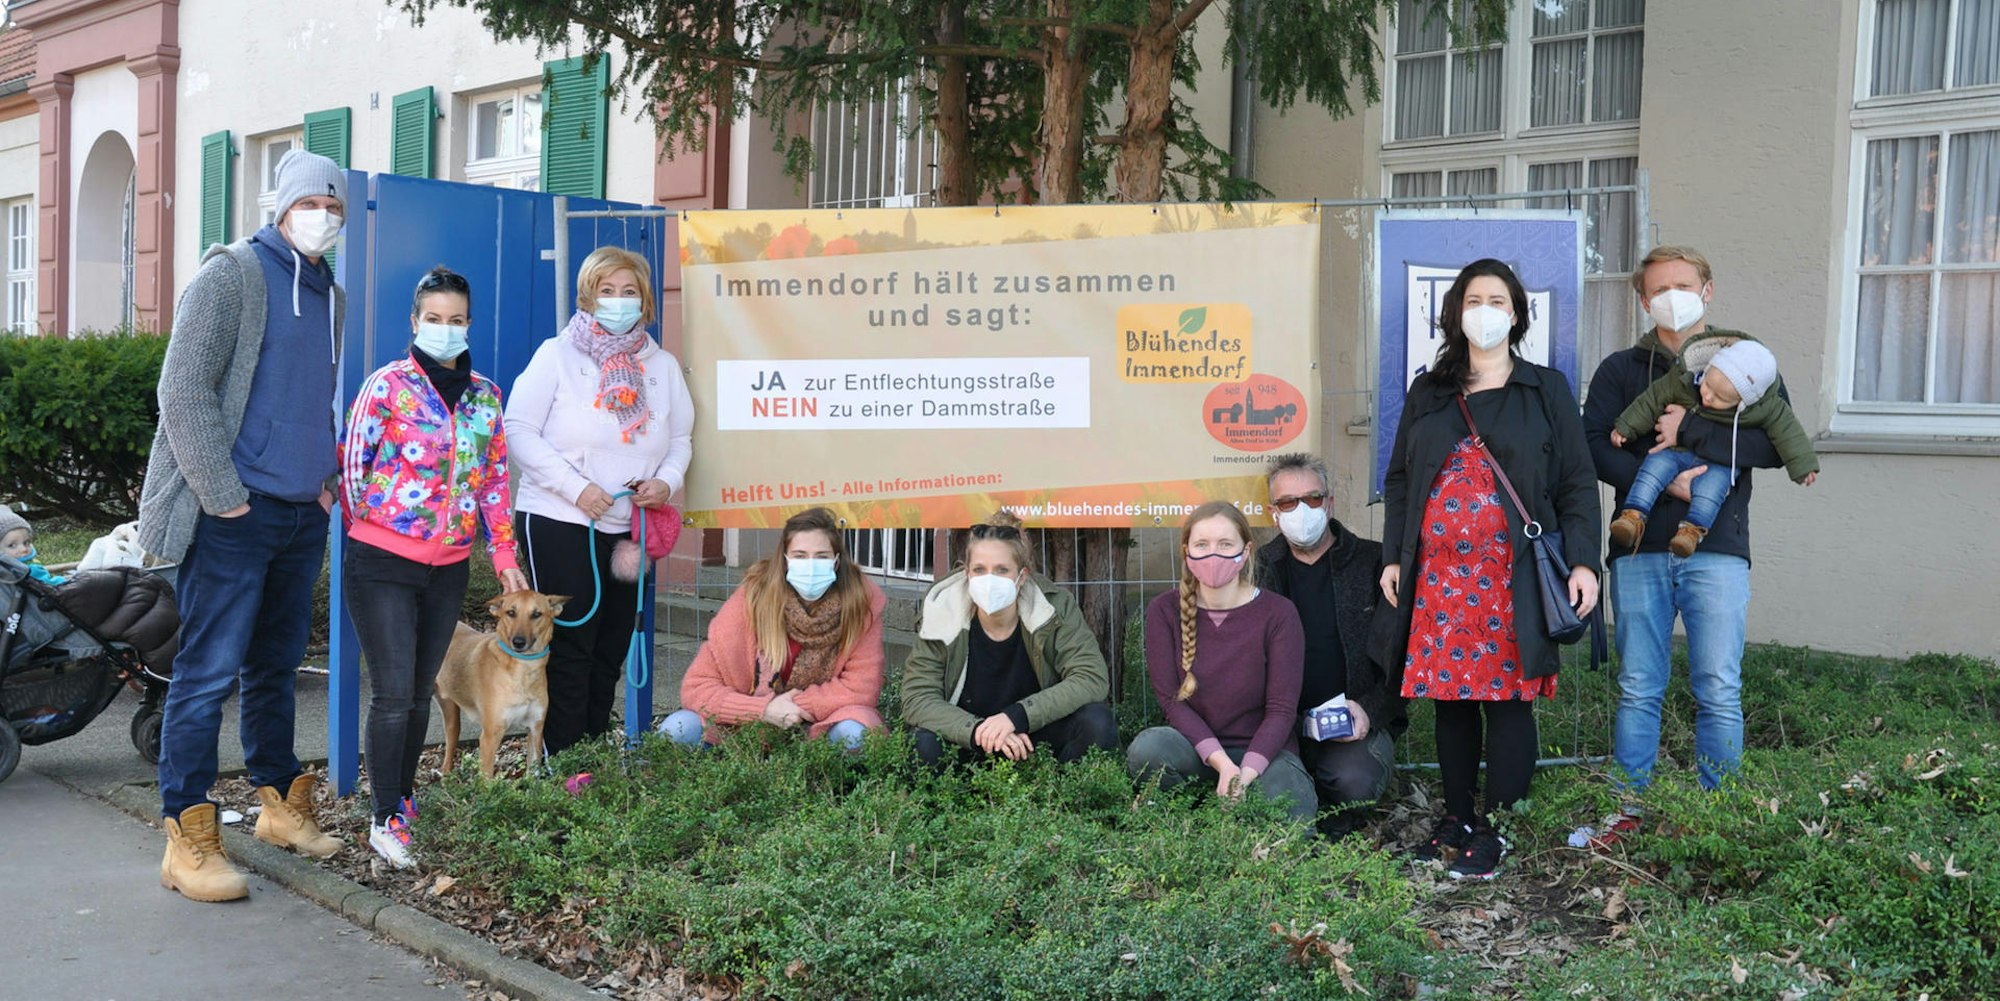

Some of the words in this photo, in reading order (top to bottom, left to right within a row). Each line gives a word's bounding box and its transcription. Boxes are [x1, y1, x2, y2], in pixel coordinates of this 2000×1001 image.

[715, 271, 898, 297] Immendorf
[914, 270, 978, 294] hält
[993, 272, 1176, 293] zusammen
[868, 303, 929, 327] und
[945, 303, 1031, 331] sagt:
[1125, 329, 1241, 352] Blühendes
[1125, 355, 1246, 379] Immendorf
[751, 370, 786, 391] JA
[804, 378, 836, 391] zur
[845, 371, 1055, 394] Entflechtungsstraße
[1257, 384, 1278, 395] 948
[752, 396, 818, 417] NEIN
[829, 404, 852, 417] zu
[861, 400, 914, 417] einer
[922, 398, 1056, 417] Dammstraße
[1225, 426, 1283, 437] Immendorf
[1213, 455, 1264, 464] Immendorf
[721, 484, 774, 504] Helft
[780, 480, 825, 500] Uns!
[842, 482, 873, 496] Alle
[879, 473, 1002, 493] Informationen:
